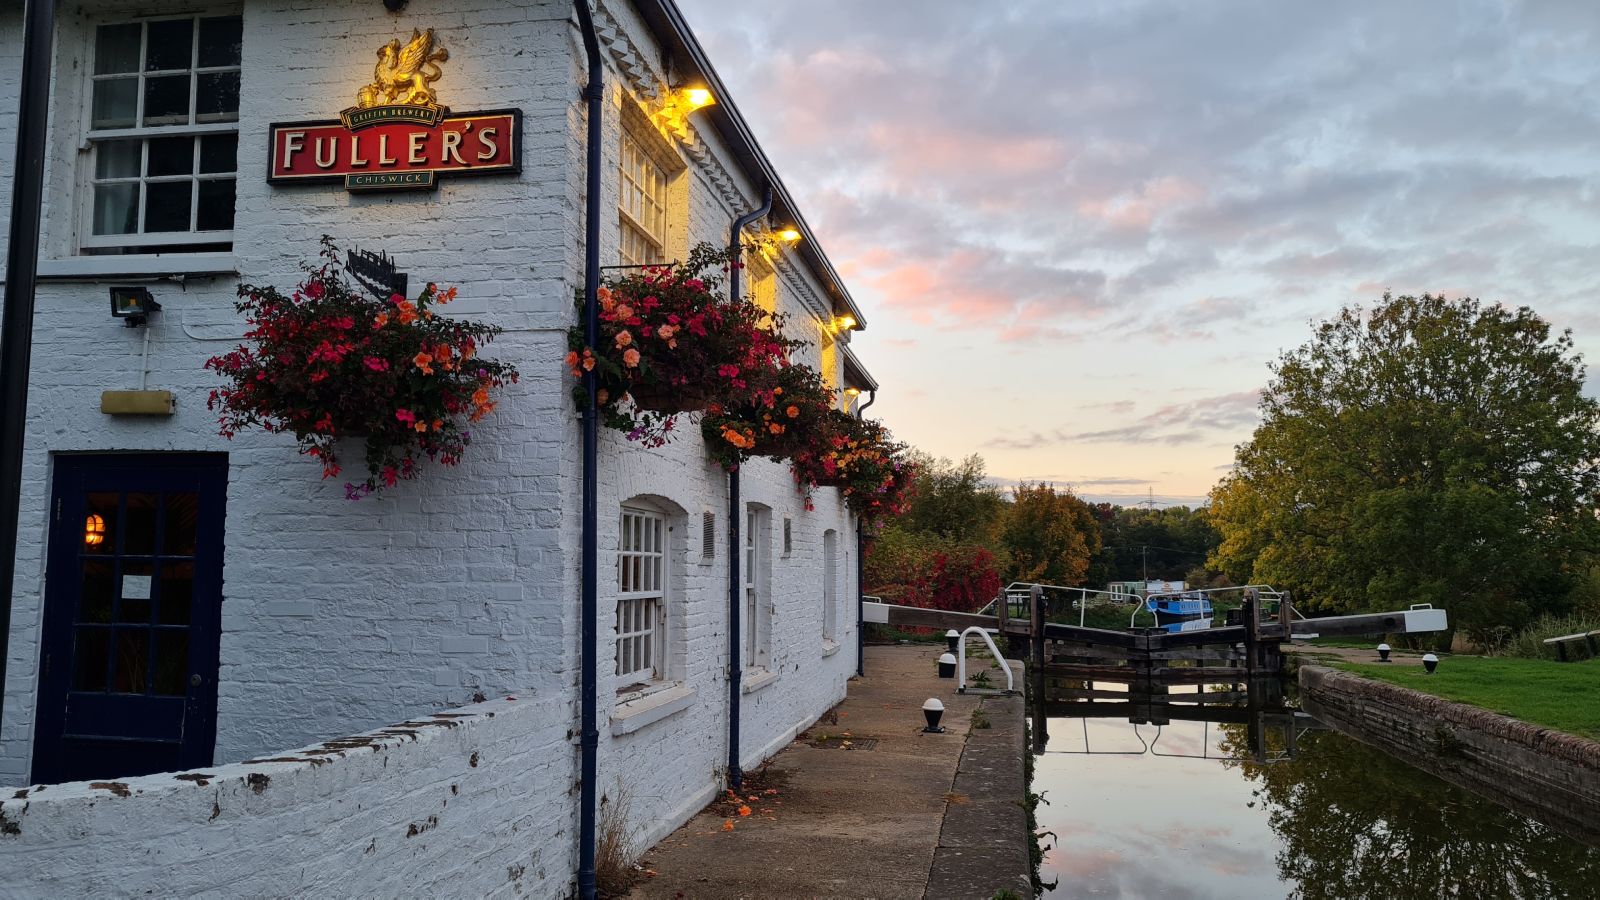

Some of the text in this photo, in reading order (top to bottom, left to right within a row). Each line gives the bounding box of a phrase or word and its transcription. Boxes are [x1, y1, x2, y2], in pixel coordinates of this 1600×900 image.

[353, 108, 431, 123] GRIFFIN BREWERY
[283, 121, 497, 168] FULLER'S
[356, 174, 422, 184] CHISWICK
